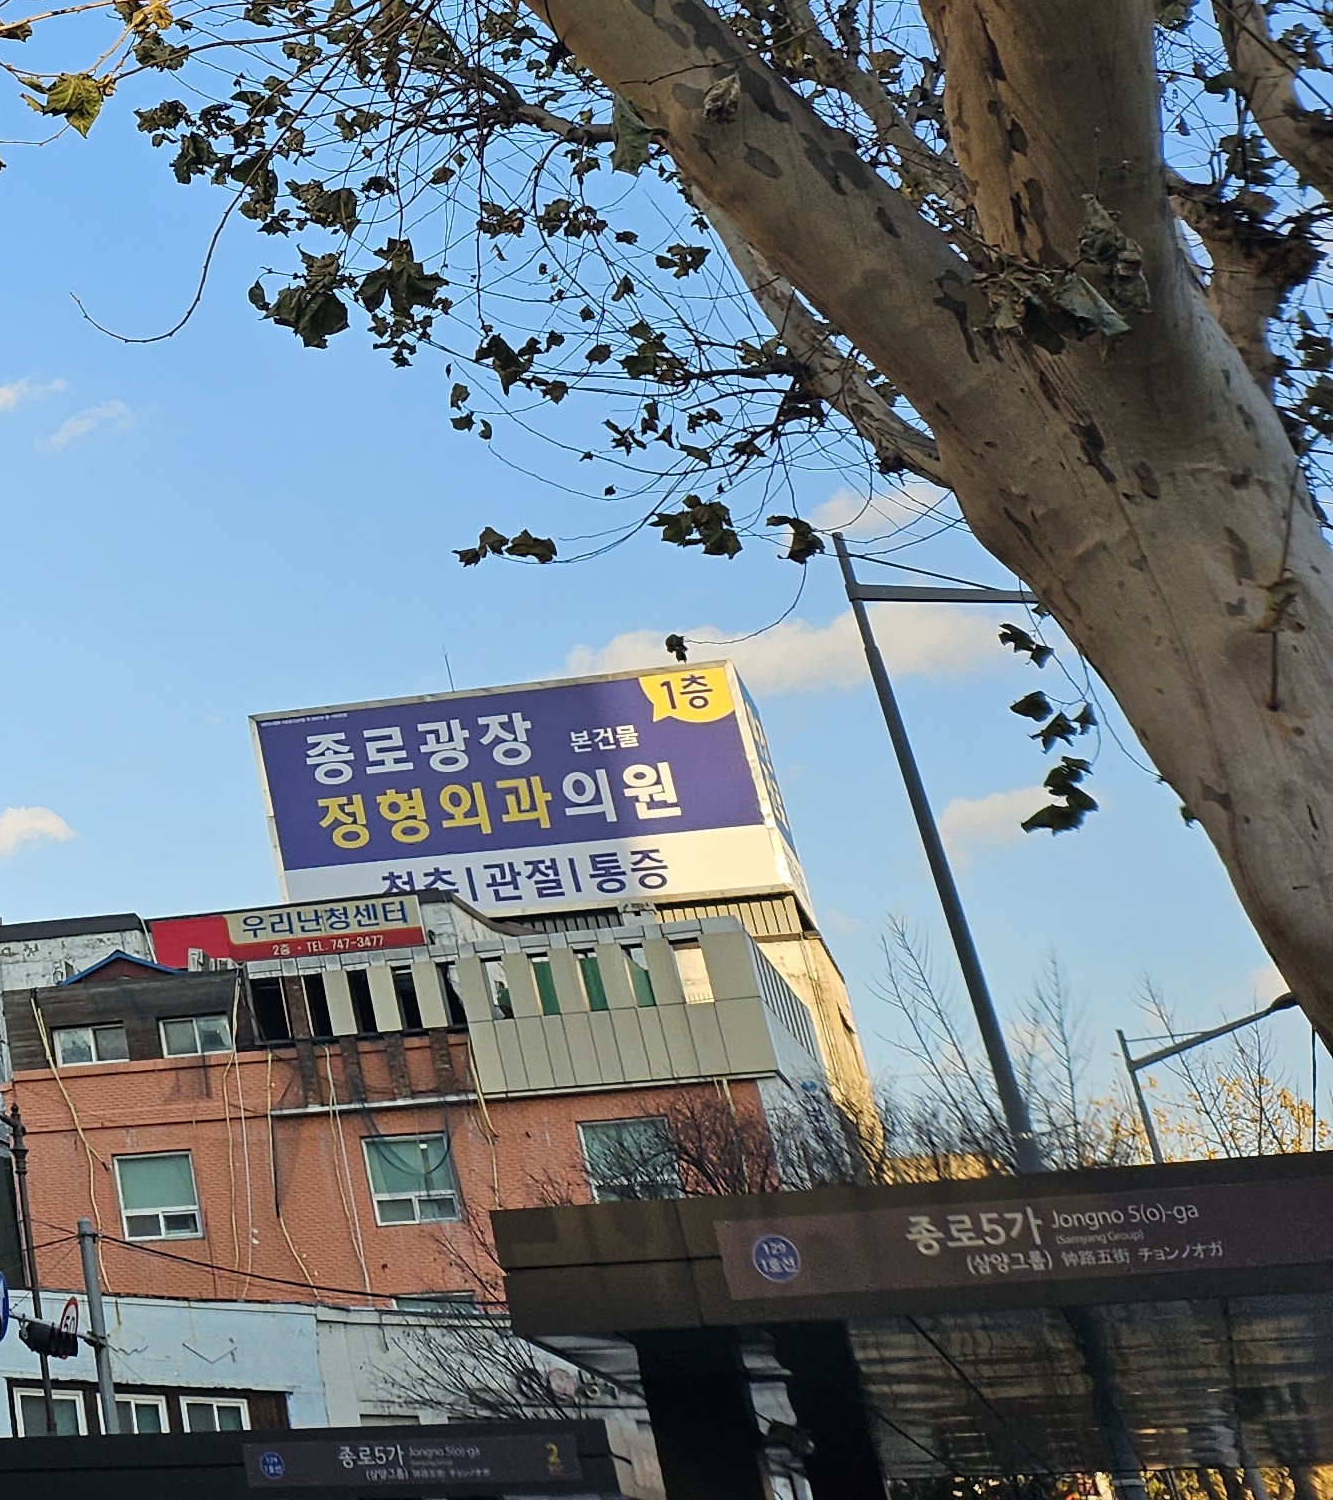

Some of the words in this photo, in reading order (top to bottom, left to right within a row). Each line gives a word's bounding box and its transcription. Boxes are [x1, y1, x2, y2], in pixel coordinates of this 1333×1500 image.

[659, 673, 714, 712] 1층
[305, 711, 533, 786] 종로광장
[569, 724, 639, 754] 본건물
[317, 760, 682, 849] 정형외과의원
[483, 858, 567, 903] 관절
[588, 848, 669, 893] 통증
[241, 900, 409, 938] 우리난청센터
[331, 934, 384, 951] 747-3477
[905, 1206, 1044, 1257] 종로5가
[1049, 1207, 1125, 1235] Jongno
[1127, 1203, 1200, 1225] 5(o)-ga
[965, 1251, 1054, 1276] (삼양그룹)
[337, 1443, 406, 1469] 종로5가
